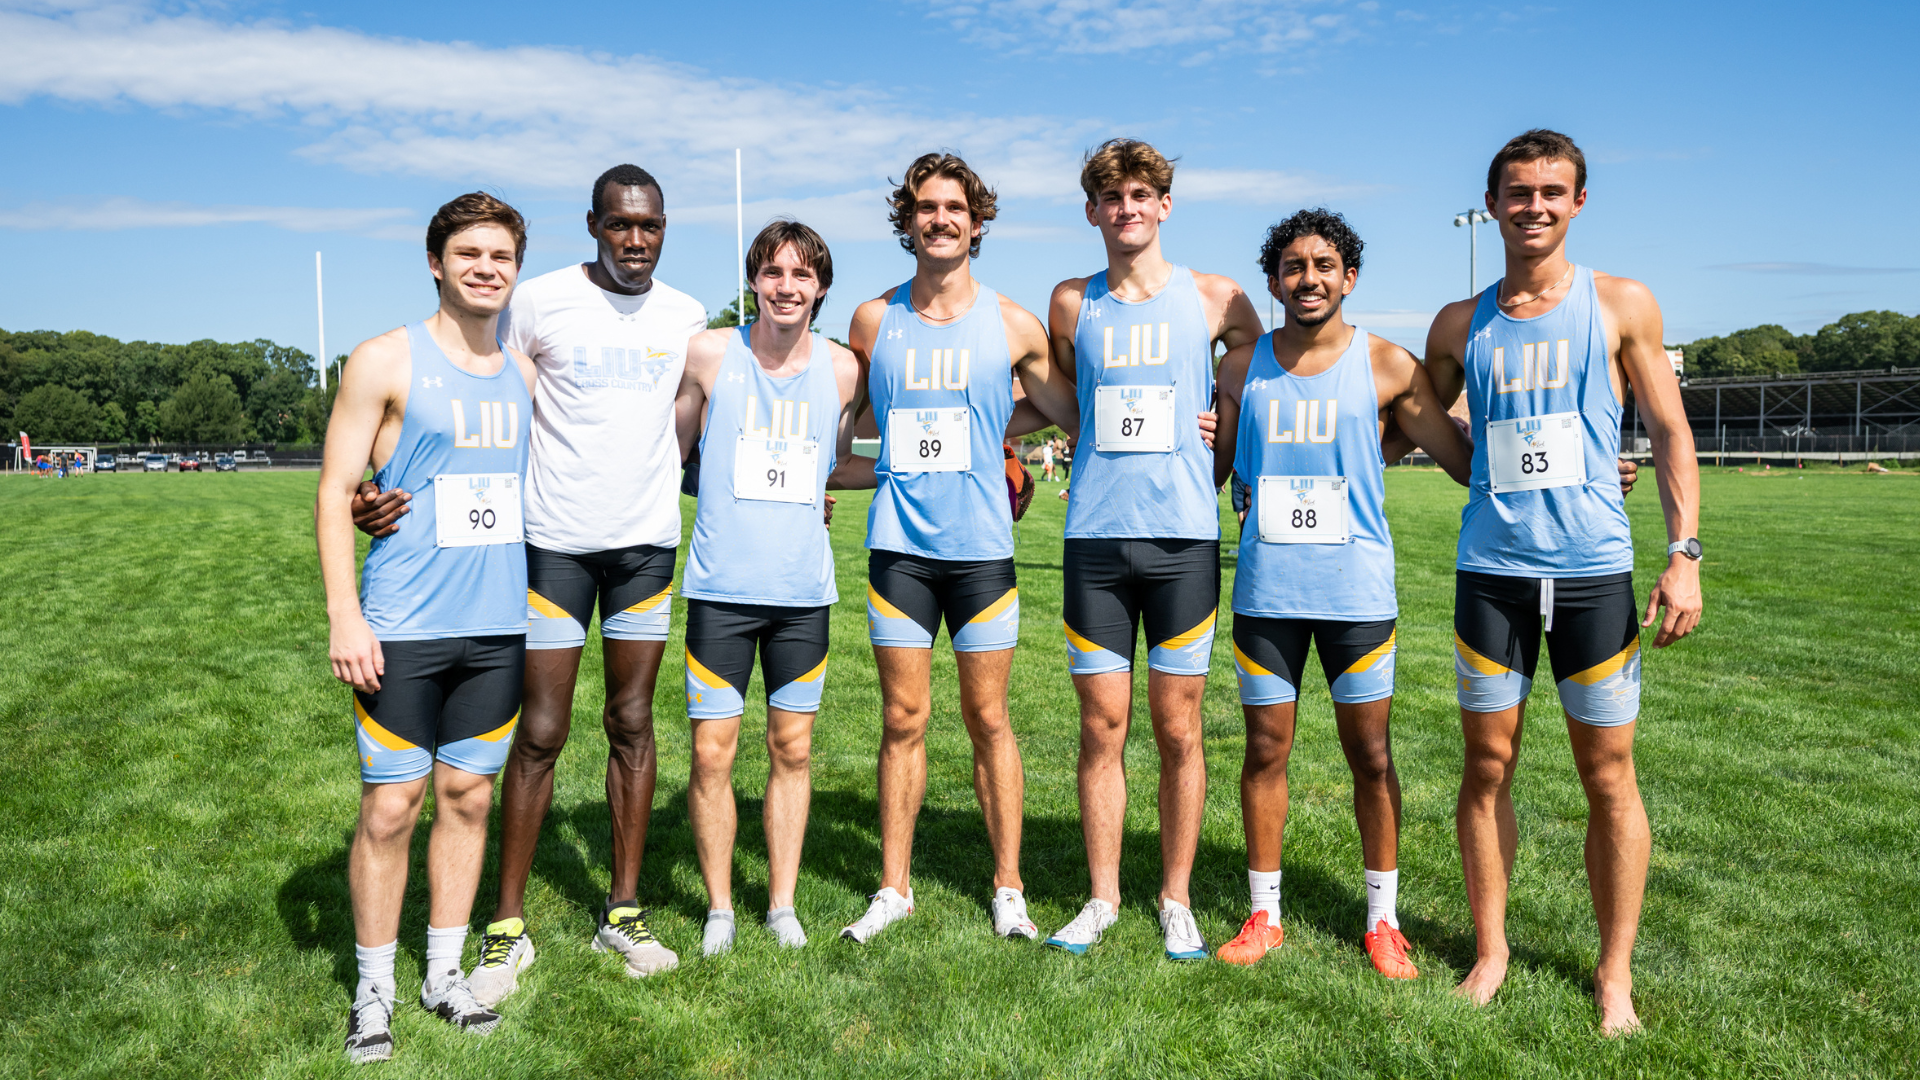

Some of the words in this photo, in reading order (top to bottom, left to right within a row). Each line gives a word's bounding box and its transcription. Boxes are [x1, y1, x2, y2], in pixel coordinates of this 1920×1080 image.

[1104, 322, 1169, 368] LIU
[573, 346, 642, 380] LIU
[905, 348, 970, 391] LIU
[1494, 339, 1569, 394] LIU
[574, 379, 609, 388] CROSS
[611, 379, 653, 392] COUNTRY
[1120, 388, 1142, 400] LIU
[451, 399, 518, 449] LIU
[745, 395, 810, 440] LIU
[916, 411, 938, 422] LIU
[1268, 399, 1338, 443] LIU
[1515, 419, 1542, 434] LIU
[1121, 417, 1145, 437] 87
[766, 440, 788, 452] LIU
[919, 439, 942, 458] 89
[1521, 452, 1549, 474] 83
[469, 477, 490, 490] LIU
[767, 468, 786, 488] 91
[1290, 478, 1314, 491] LIU
[469, 508, 496, 530] 90
[1291, 508, 1317, 528] 88
